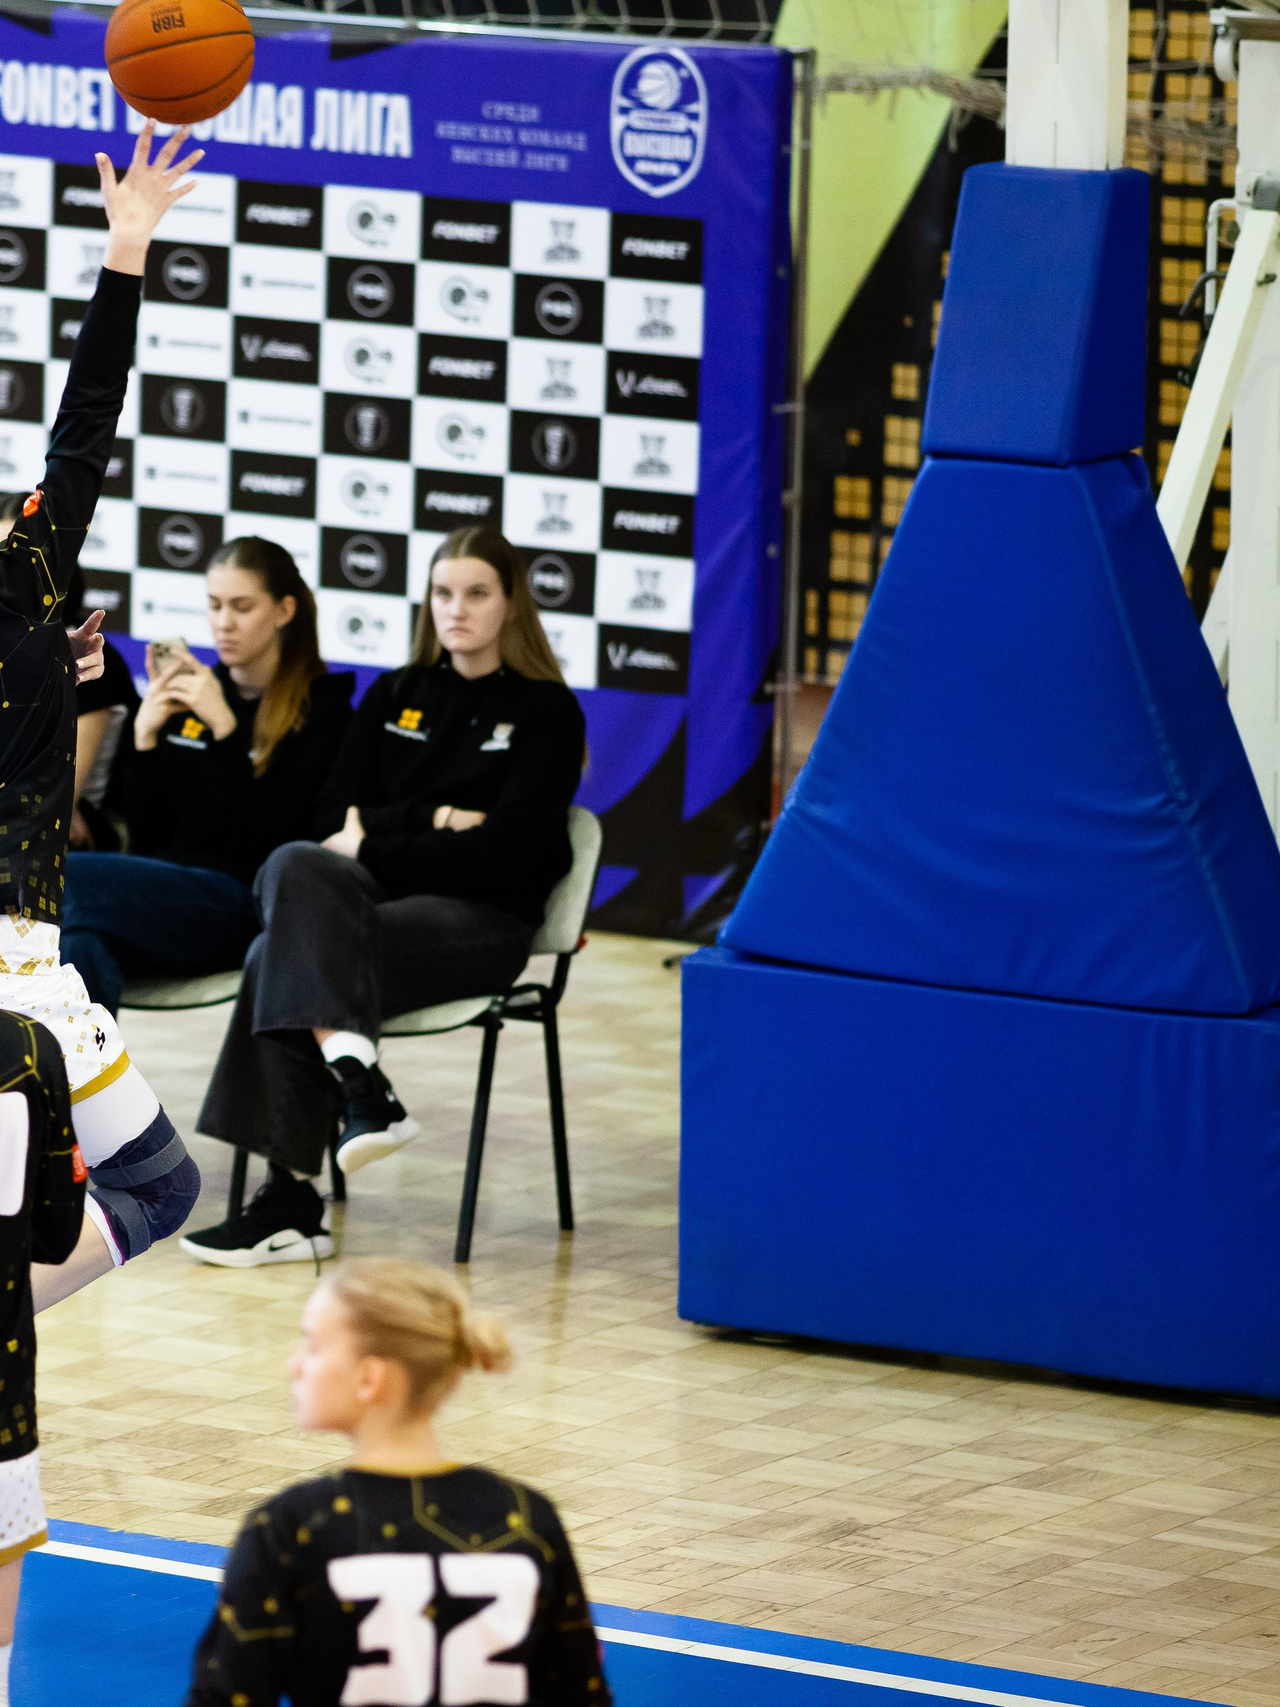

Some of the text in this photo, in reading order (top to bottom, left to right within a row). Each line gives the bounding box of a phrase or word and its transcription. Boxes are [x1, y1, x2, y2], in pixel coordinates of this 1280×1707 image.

[152, 13, 185, 33] FIBA
[127, 83, 304, 149] ШАЯ
[311, 88, 412, 158] ЛИГА
[246, 204, 312, 227] FONBET
[432, 221, 499, 243] FONBET
[621, 238, 688, 260] FONBET
[428, 356, 495, 380] FONBET
[240, 473, 305, 496] FONBET
[424, 491, 491, 515] FONBET
[613, 511, 680, 534] FONBET
[326, 1552, 540, 1707] 32
